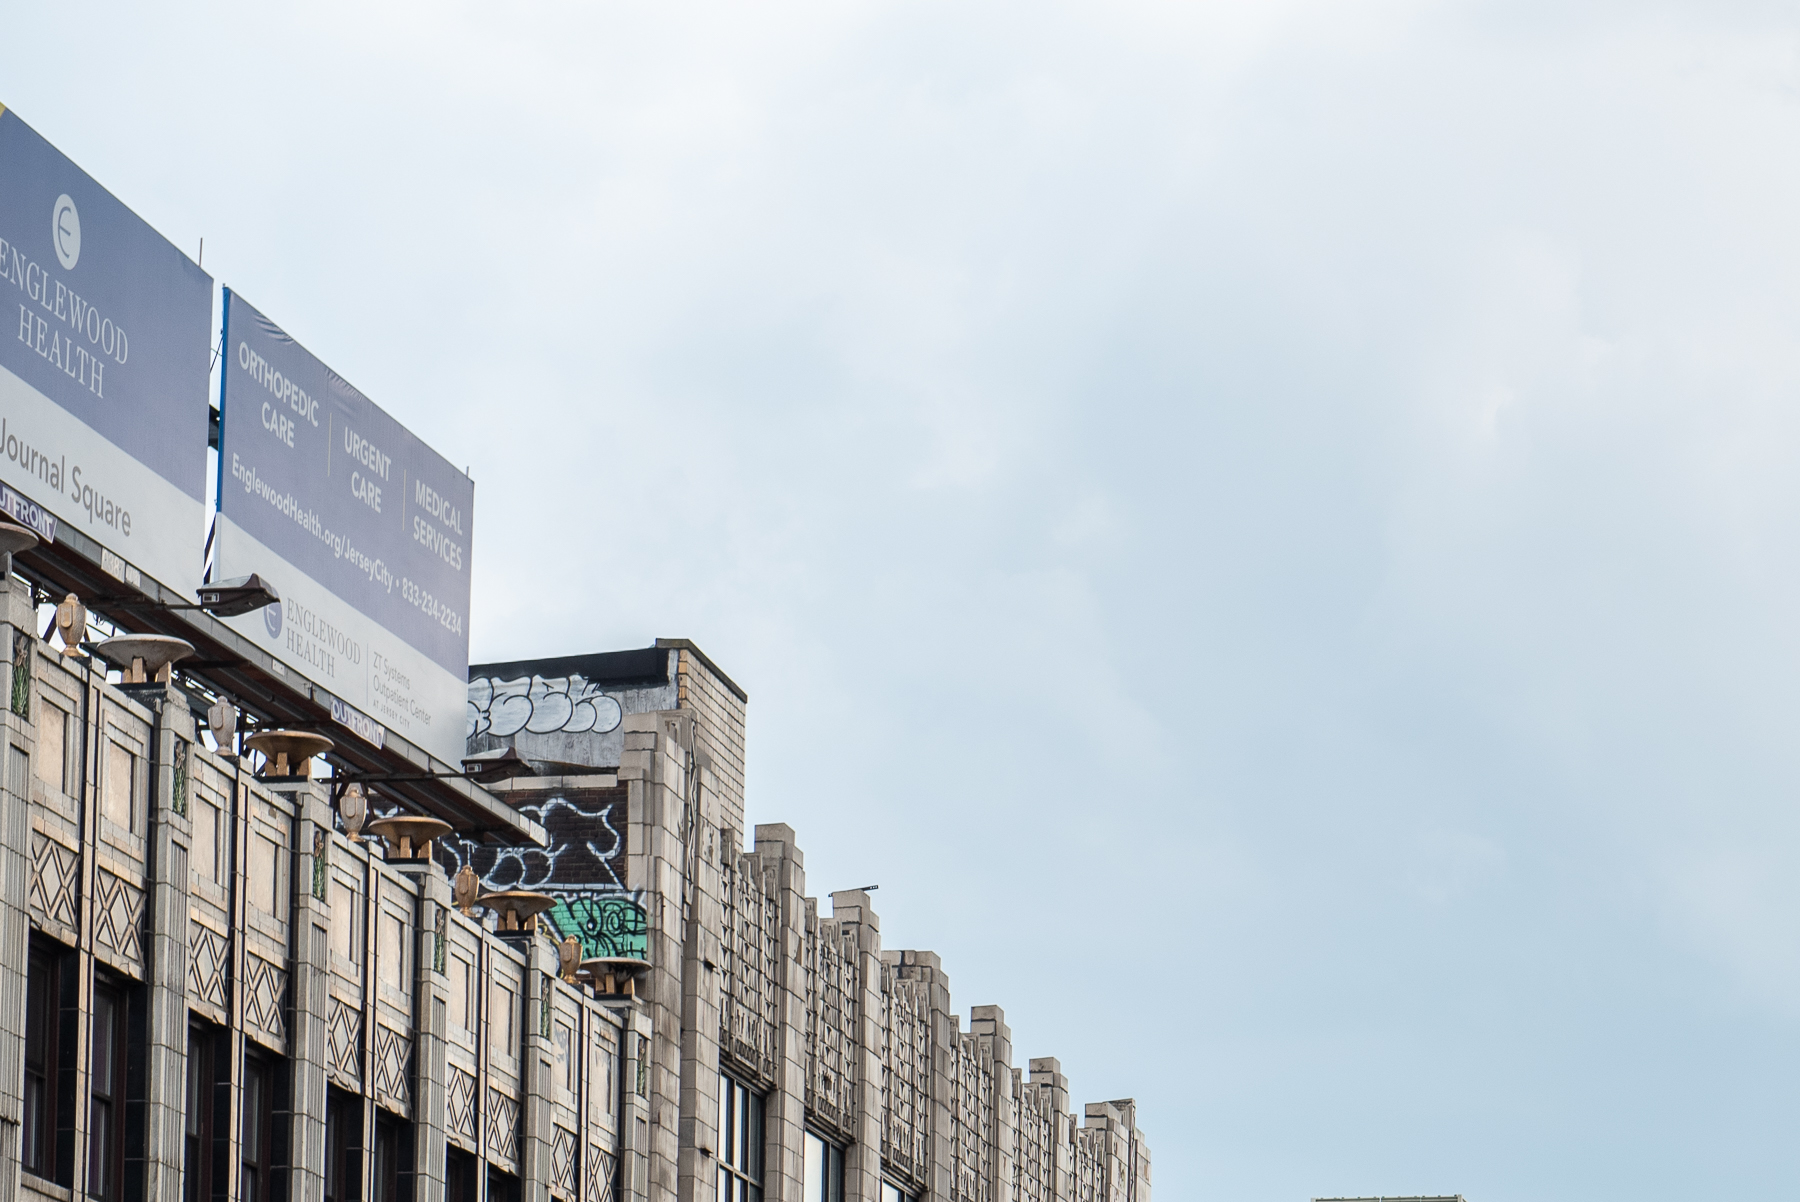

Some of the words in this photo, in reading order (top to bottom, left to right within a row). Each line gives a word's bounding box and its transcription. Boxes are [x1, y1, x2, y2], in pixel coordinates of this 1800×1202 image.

[0, 237, 128, 365] ENGLEWOOD
[17, 303, 105, 399] HEALTH
[238, 341, 320, 427] ORTHOPEDIC
[261, 401, 295, 449] CARE
[0, 417, 65, 494] Journal
[71, 465, 131, 537] Square
[344, 426, 392, 482] URGENT
[0, 487, 53, 538] UTFRONT
[351, 471, 382, 514] CARE
[415, 479, 463, 536] MEDICAL
[232, 452, 394, 594] EnglewoodHealth.org/JerseyCity
[402, 577, 462, 637] 833-234-2234
[413, 515, 462, 571] SERVICES
[286, 597, 361, 665] ENGLEWOOD
[286, 627, 336, 679] HEALTH
[373, 651, 382, 670] ZT
[383, 658, 411, 690] Systems
[331, 699, 384, 745] OUTFRONT
[373, 675, 409, 710] Outpatient
[409, 702, 432, 727] Center
[380, 703, 398, 721] JERSEY
[400, 716, 411, 730] CITY
